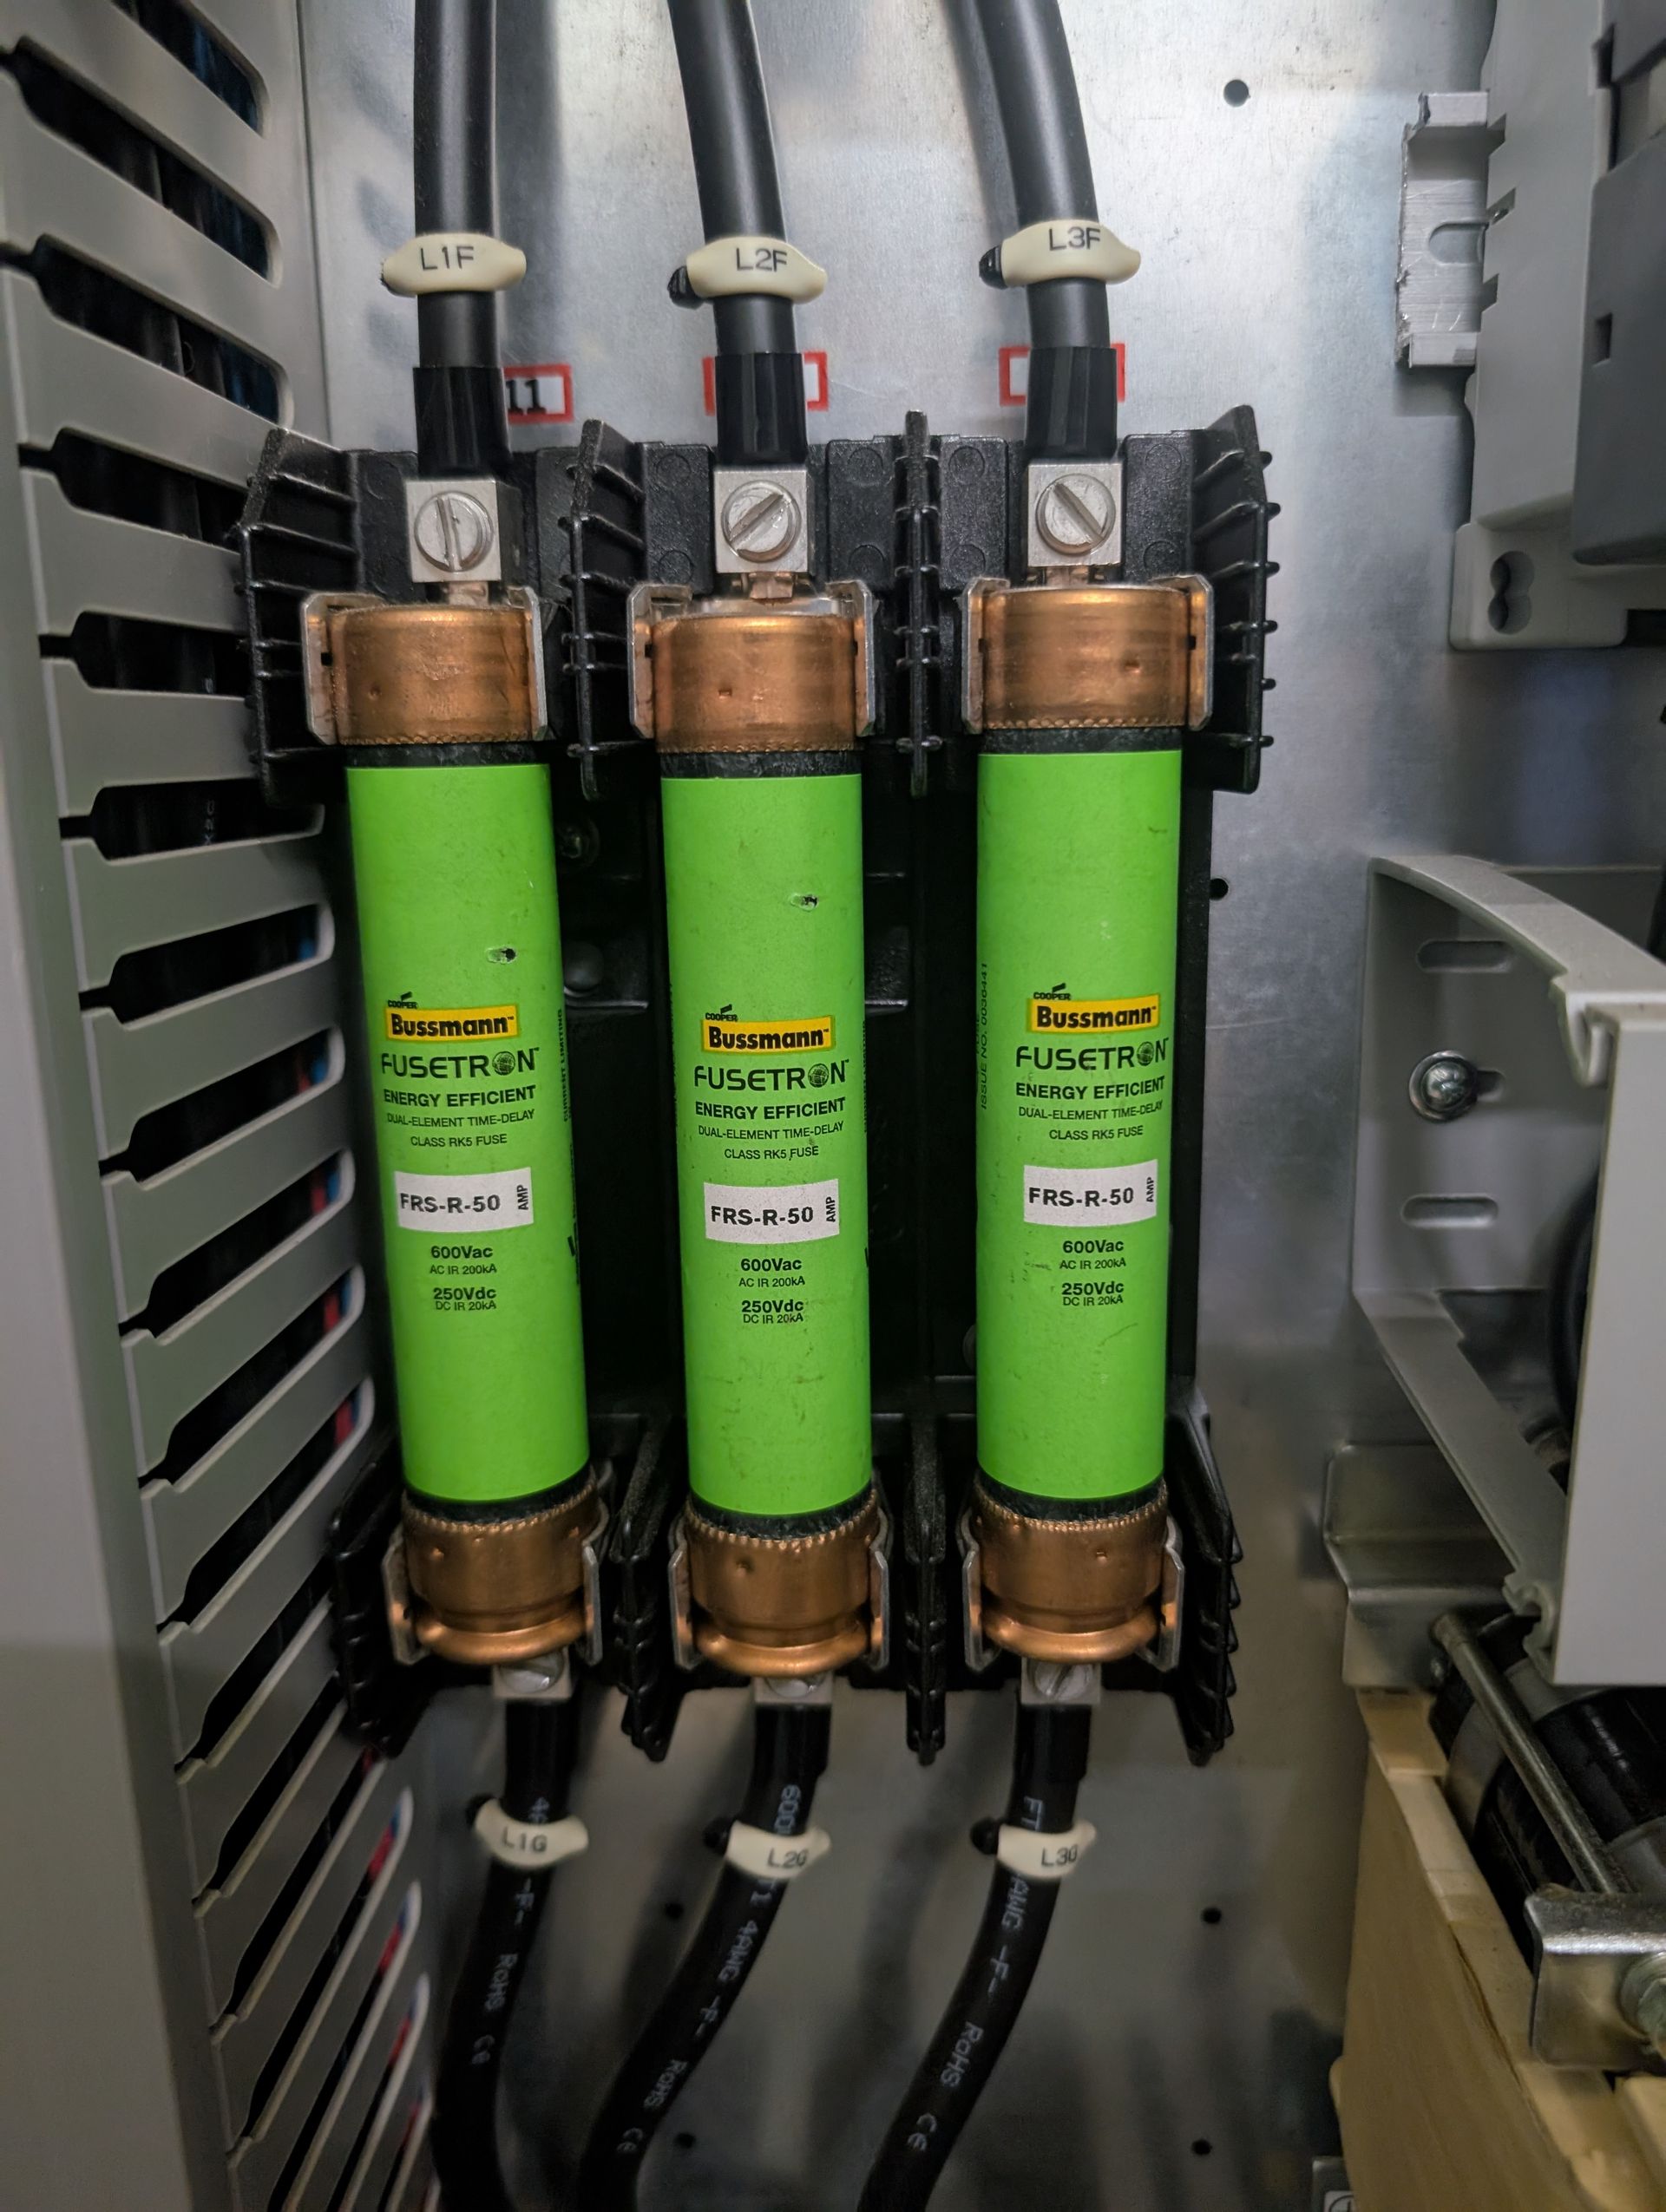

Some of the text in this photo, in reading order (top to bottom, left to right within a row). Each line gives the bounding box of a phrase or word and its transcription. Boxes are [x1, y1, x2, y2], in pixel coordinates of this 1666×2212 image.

[1048, 226, 1100, 251] L3F
[420, 245, 474, 272] L1F
[735, 247, 789, 272] L2F
[1033, 991, 1071, 1000] COOPER
[388, 999, 417, 1009] COOPER
[705, 1012, 738, 1022] COOPER
[384, 1085, 535, 1107] ENERGY EFFICIENT
[1016, 1077, 1164, 1100] ENERGY EFFICIENT
[695, 1097, 845, 1120] ENERGY EFFICIENT
[1019, 1100, 1162, 1119] DUAL-ELEMENT TIME-DELAY
[387, 1109, 535, 1127] DUAL-ELEMENT TIME-DELAY
[699, 1121, 843, 1139] DUAL-ELEMENT TIME-DELAY
[1049, 1126, 1144, 1140] CLASS RK5 FUSE
[410, 1134, 507, 1148] CLASS RK5 FUSE
[724, 1146, 819, 1160] CLASS RK5 FUSE
[1145, 1177, 1154, 1202] AMP
[400, 1193, 501, 1214] FRS-R-50
[517, 1185, 528, 1210] AMP
[1028, 1188, 1133, 1207] FRS-R-50
[711, 1206, 813, 1226] FRS-R-50
[826, 1196, 836, 1222] AMP
[430, 1246, 493, 1260] 600Vac
[1062, 1240, 1124, 1253] 600Vac
[430, 1264, 497, 1274] AC IR 200kA
[740, 1258, 802, 1272] 600Vac
[1059, 1258, 1126, 1269] AC IR 200kA
[738, 1276, 805, 1287] AC IR 200kA
[1061, 1281, 1125, 1296] 250Vdc
[433, 1286, 496, 1300] 250Vdc
[1062, 1295, 1124, 1306] DC IR 20kA
[436, 1300, 496, 1310] DC IR 20kA
[741, 1299, 803, 1313] 250Vdc
[743, 1312, 803, 1323] DC IR 20kA
[502, 1826, 548, 1852] L1G
[1001, 1875, 1030, 1930] AWG
